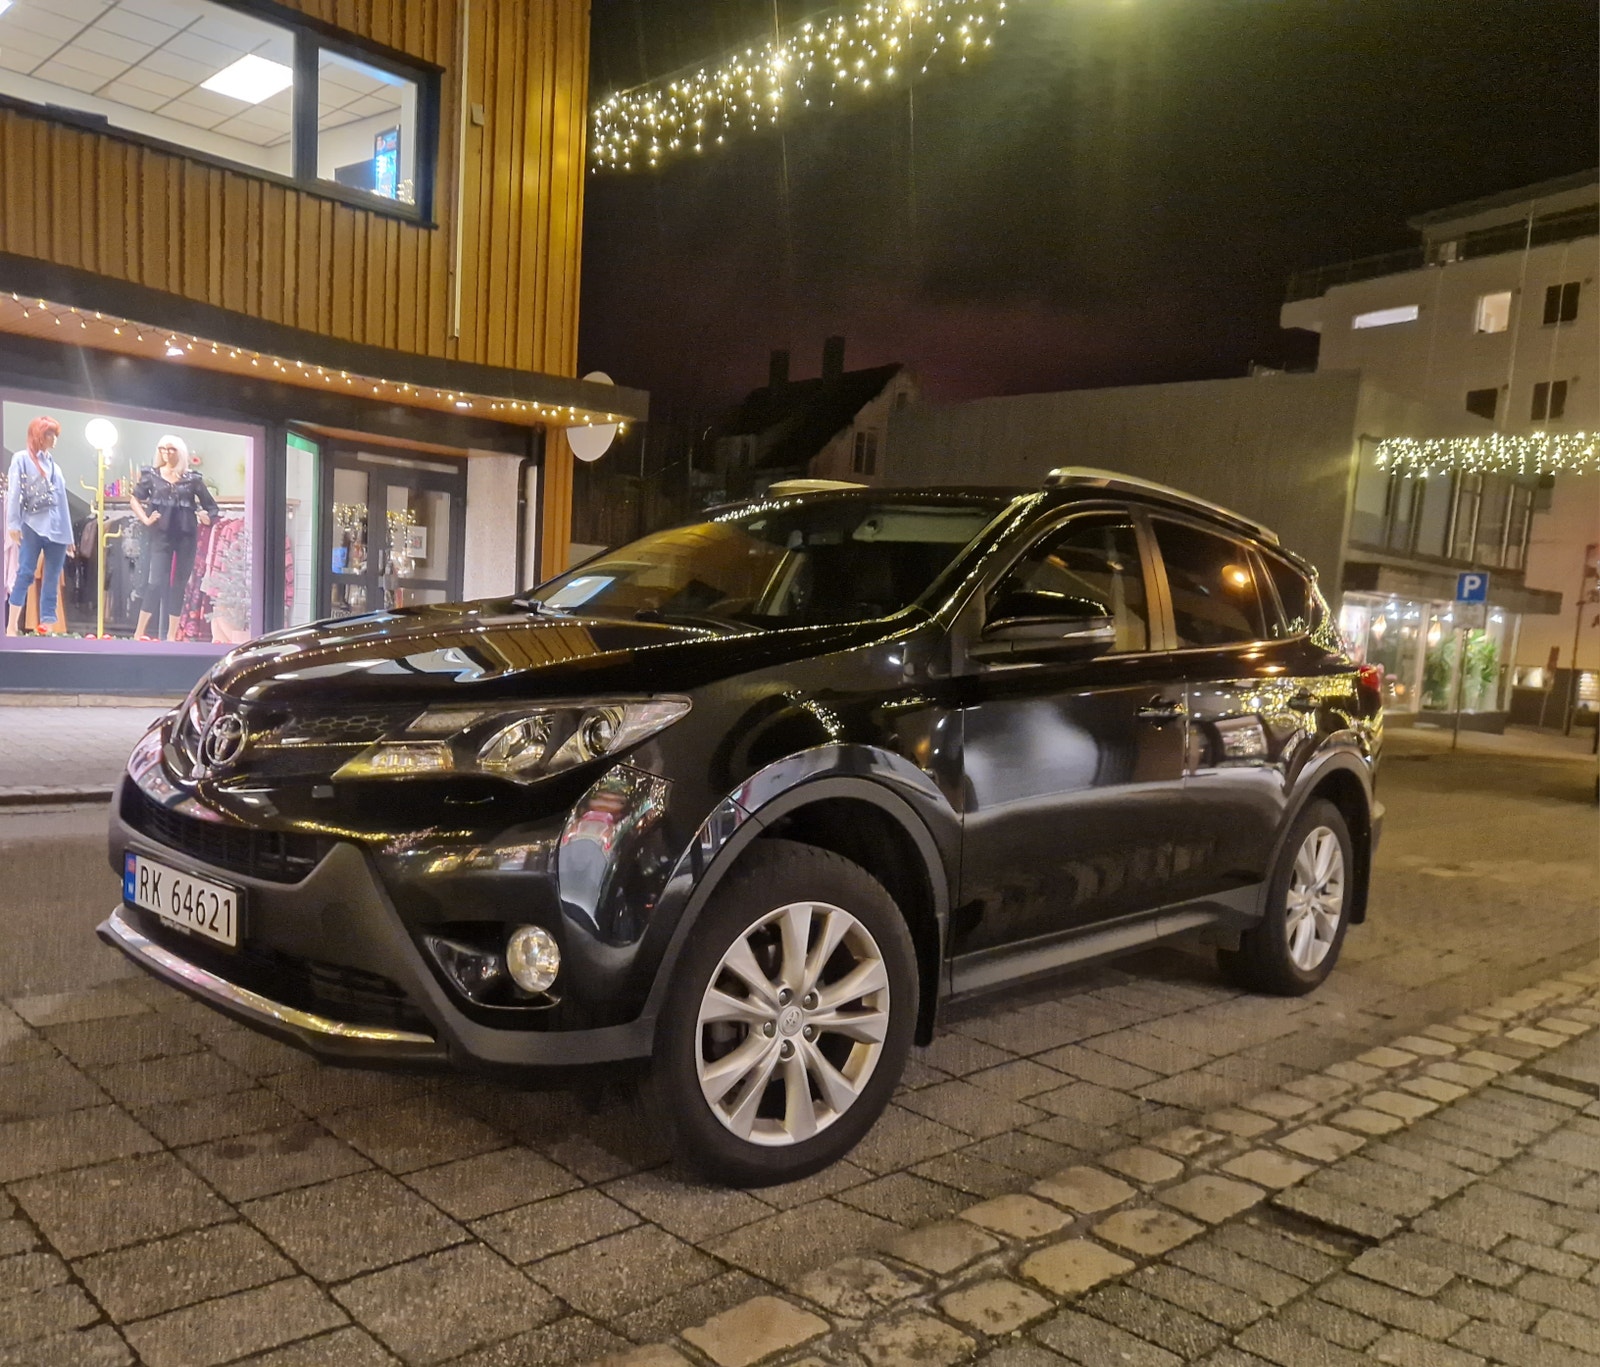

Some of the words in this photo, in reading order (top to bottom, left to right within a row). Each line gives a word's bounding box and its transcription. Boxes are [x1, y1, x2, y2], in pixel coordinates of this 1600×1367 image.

[1462, 575, 1482, 599] P
[140, 865, 162, 908] RK
[171, 879, 232, 938] 64621
